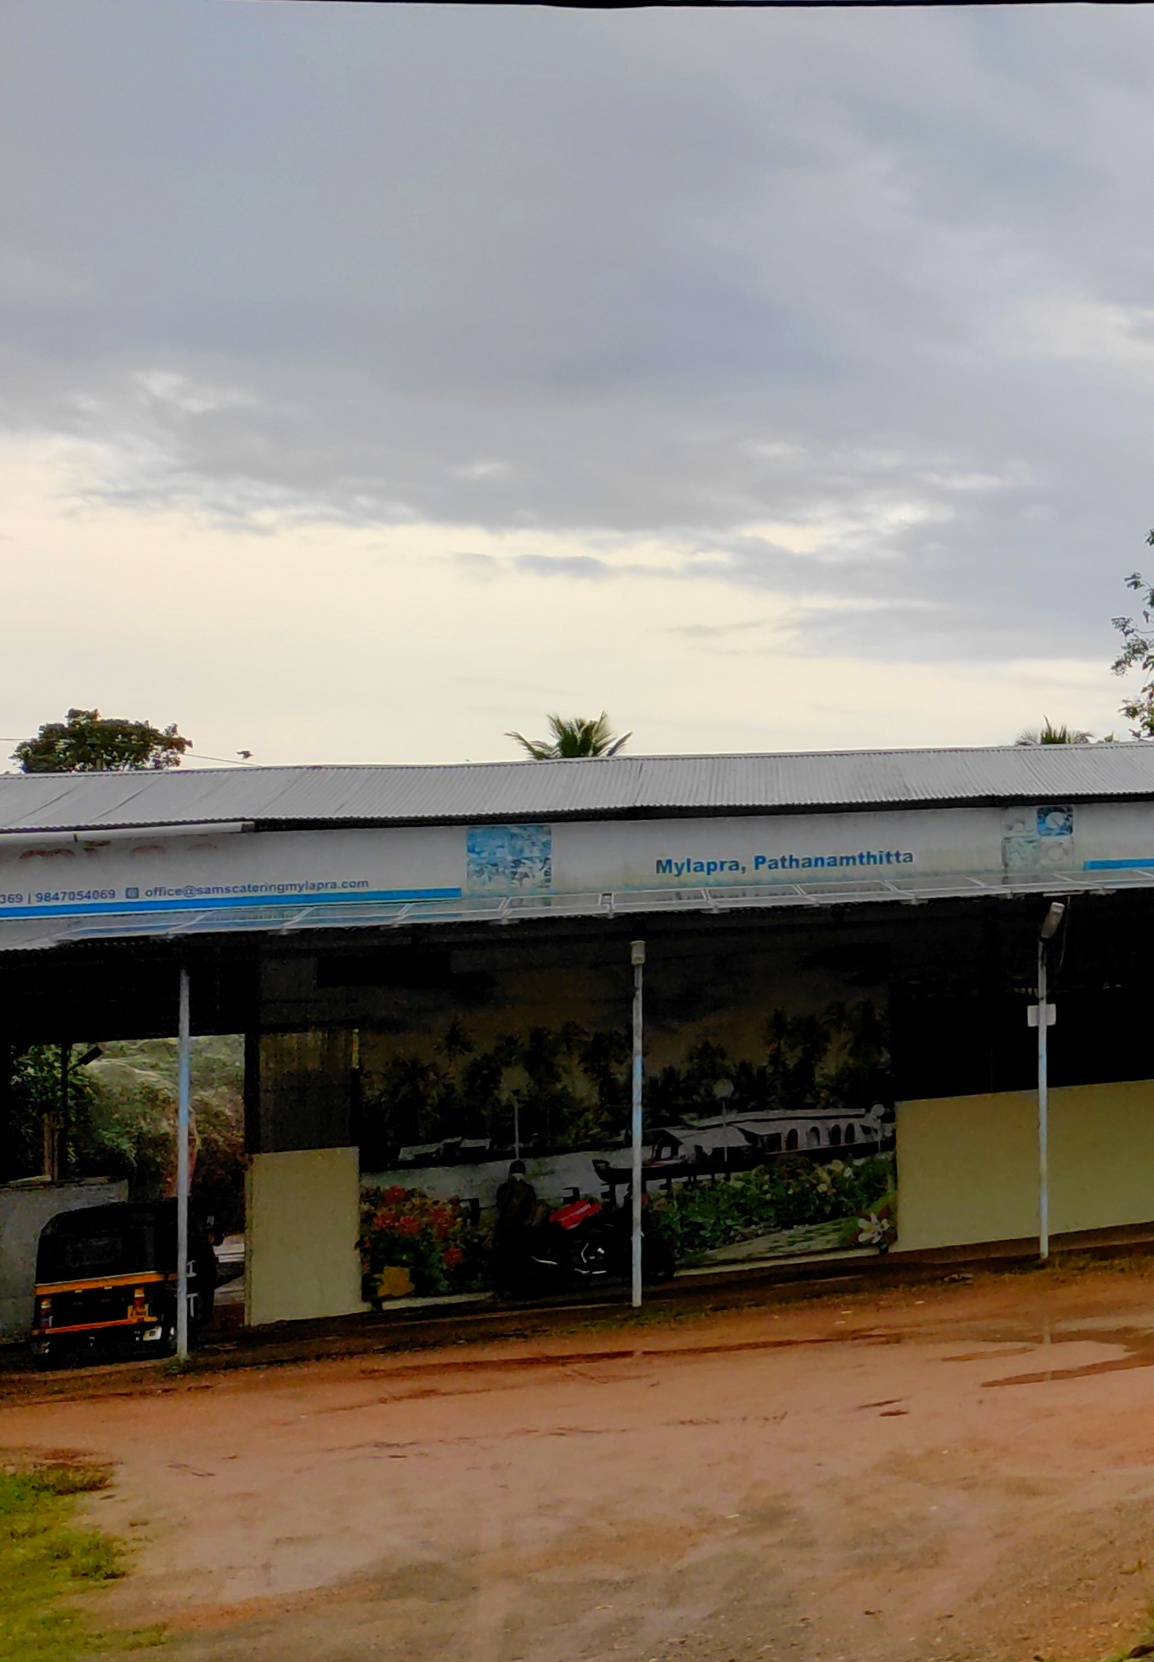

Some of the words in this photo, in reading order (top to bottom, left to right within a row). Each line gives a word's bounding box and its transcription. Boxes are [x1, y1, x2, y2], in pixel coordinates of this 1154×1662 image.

[656, 858, 747, 877] Mylapra,
[753, 850, 914, 870] Pathanamthitta
[35, 888, 116, 903] 9847054069
[144, 880, 370, 899] office@samscateringmylapra.com
